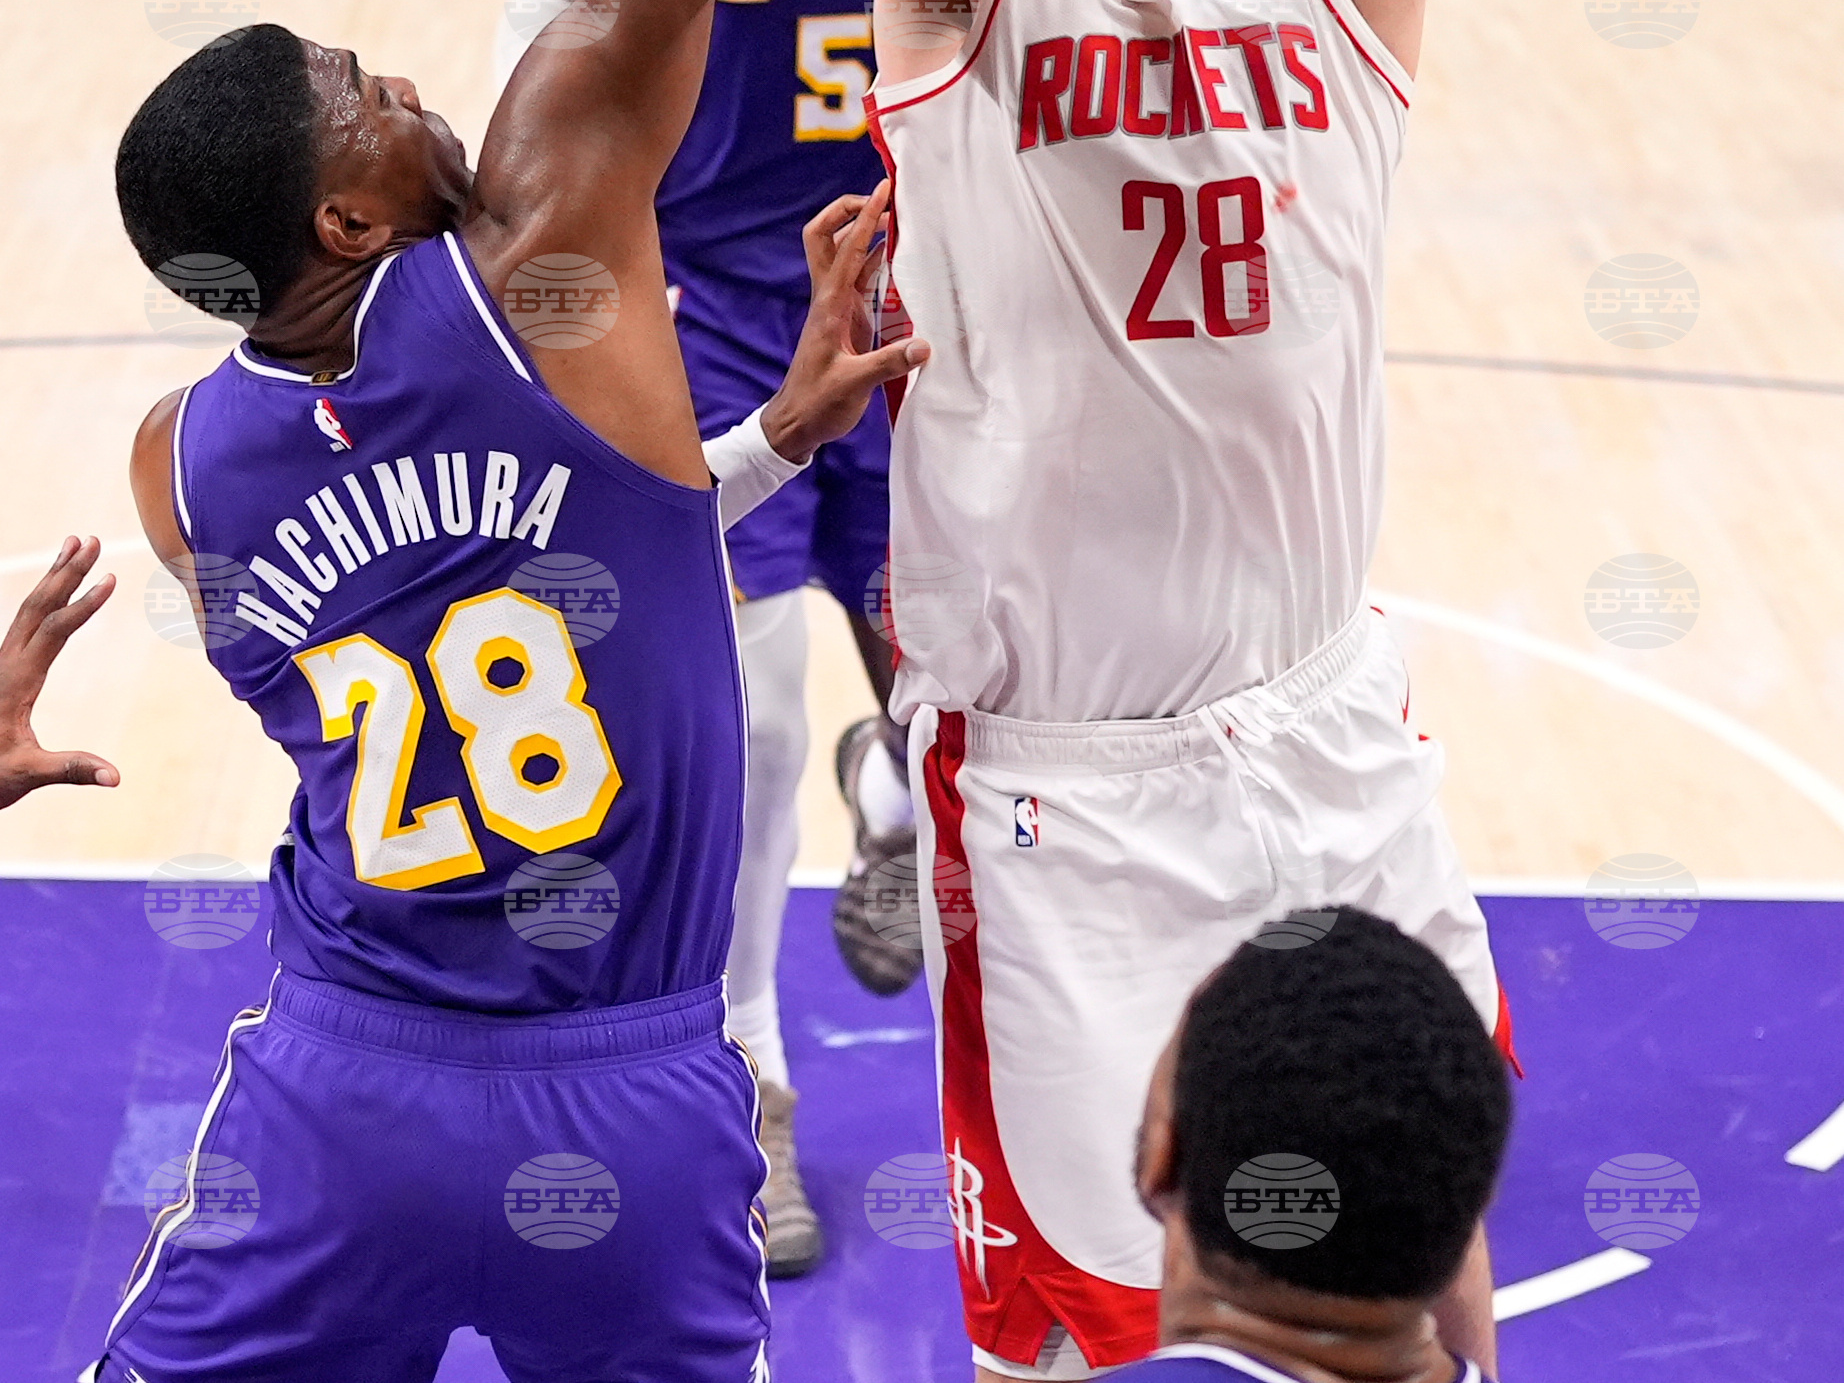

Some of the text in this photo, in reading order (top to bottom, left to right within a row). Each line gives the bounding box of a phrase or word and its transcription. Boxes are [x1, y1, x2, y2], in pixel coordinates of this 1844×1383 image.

[793, 13, 873, 142] 5
[1016, 22, 1329, 154] ROCKETS
[1121, 176, 1270, 341] 28
[235, 450, 572, 647] HACHIMURA
[291, 586, 623, 891] 28
